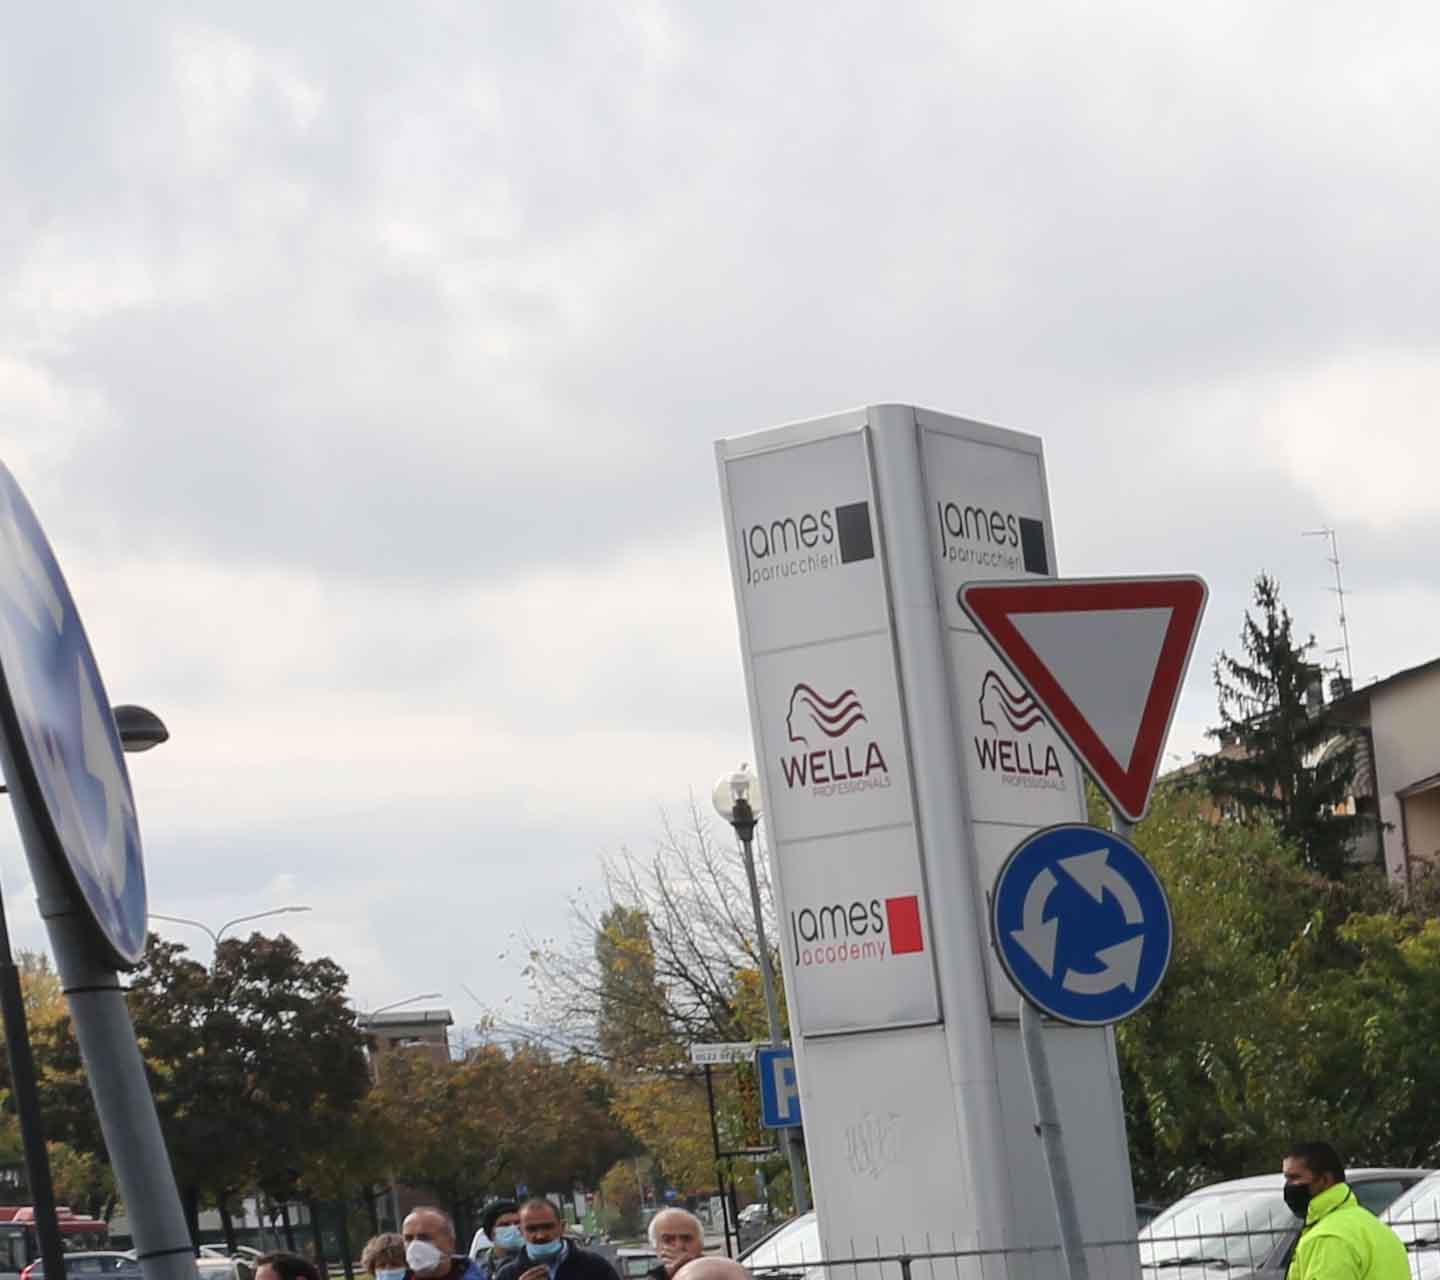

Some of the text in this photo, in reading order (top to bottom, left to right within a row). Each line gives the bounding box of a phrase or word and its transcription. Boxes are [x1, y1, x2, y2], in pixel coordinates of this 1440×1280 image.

[741, 508, 835, 585] james
[936, 500, 1019, 558] james
[752, 550, 840, 588] parrucchieri
[780, 741, 889, 789] WELLA
[973, 735, 1064, 778] WELLA
[791, 899, 885, 966] james
[802, 940, 887, 967] academy
